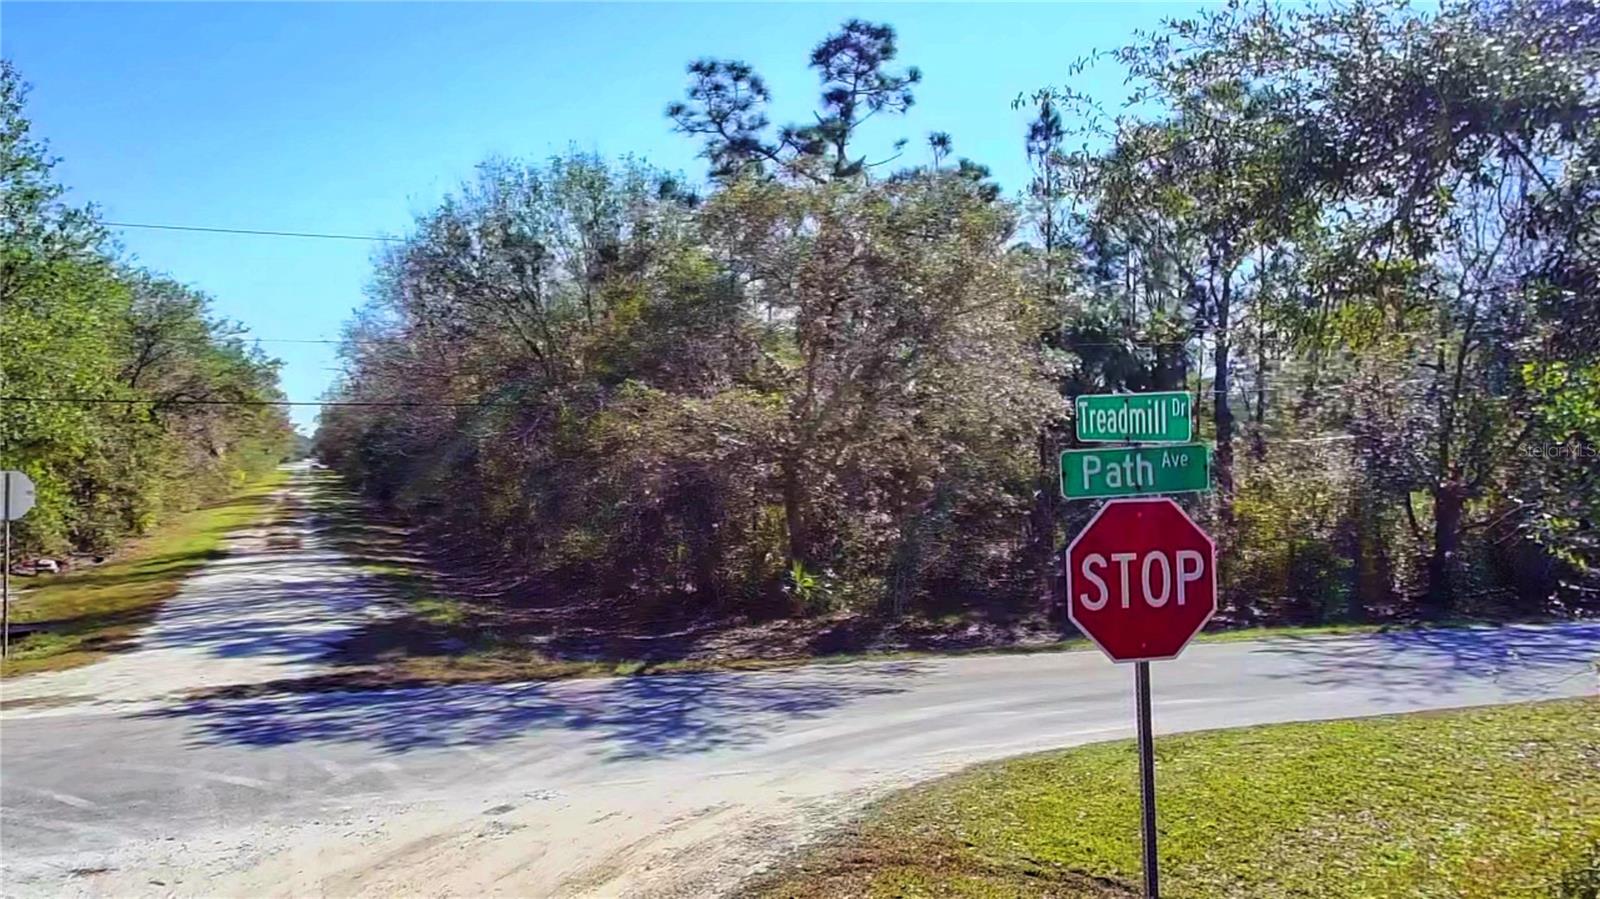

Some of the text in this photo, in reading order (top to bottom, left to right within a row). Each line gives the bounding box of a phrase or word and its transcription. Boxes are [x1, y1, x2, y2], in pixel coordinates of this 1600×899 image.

[1079, 398, 1187, 435] Treadmill Dr
[1082, 451, 1189, 490] Path Ave
[1080, 550, 1204, 611] STOP
